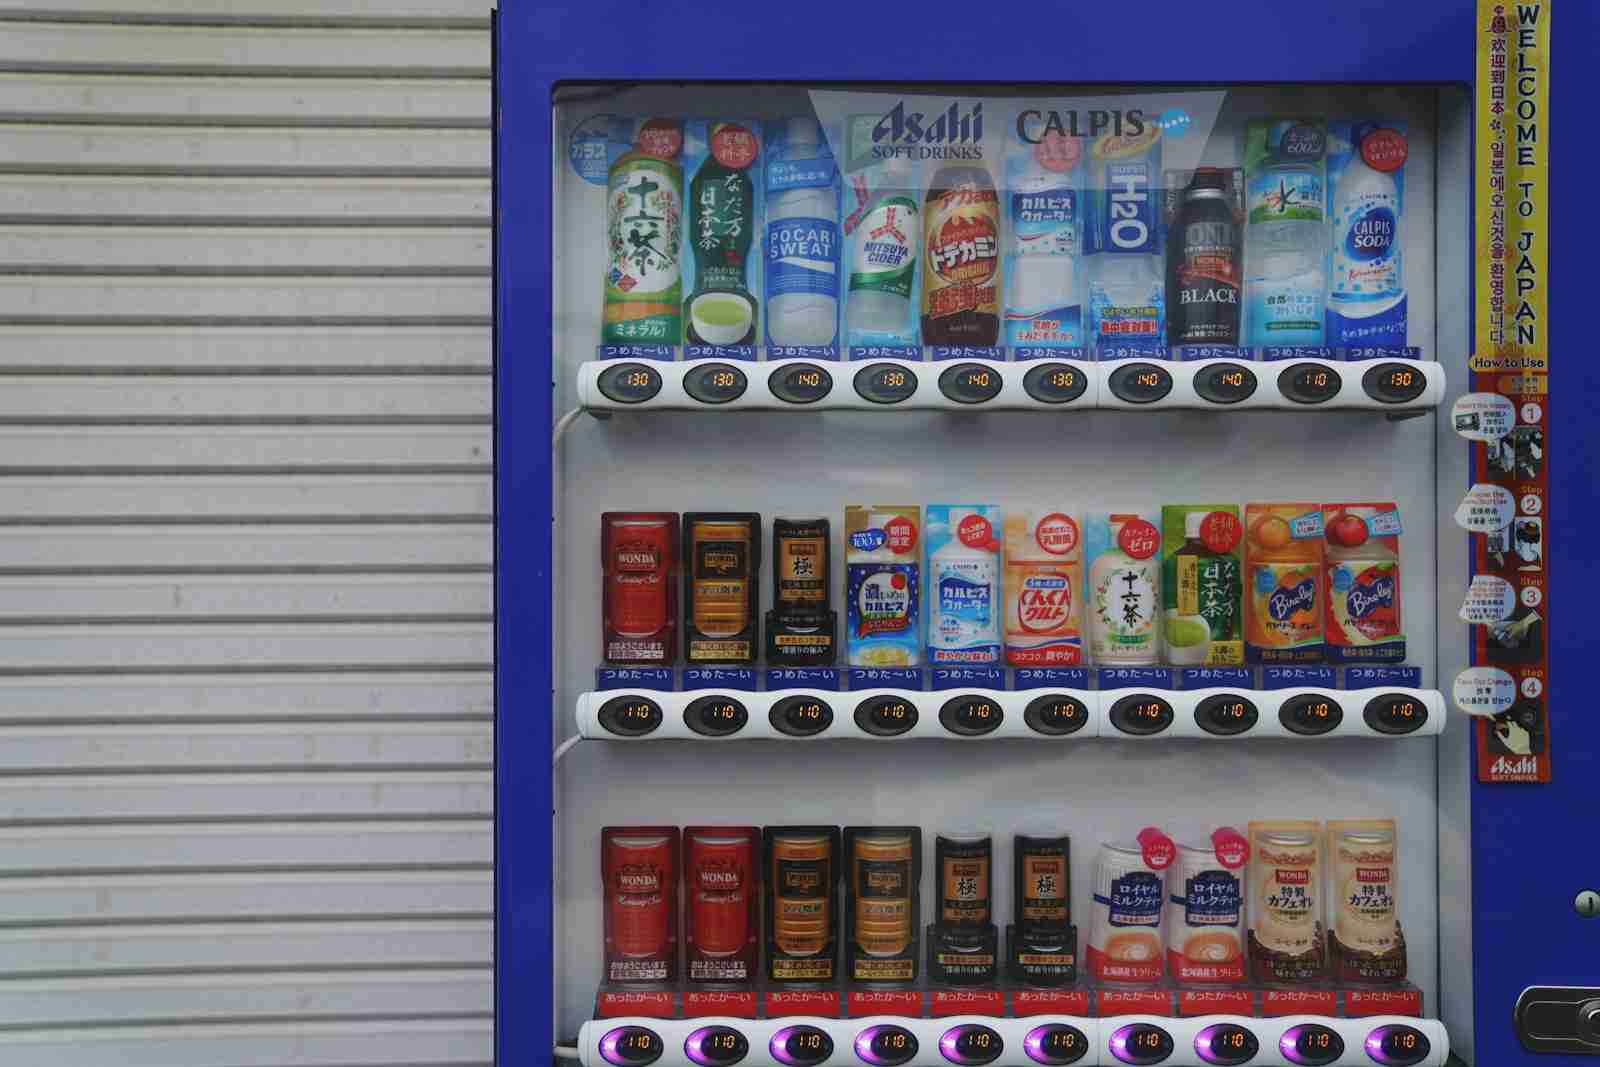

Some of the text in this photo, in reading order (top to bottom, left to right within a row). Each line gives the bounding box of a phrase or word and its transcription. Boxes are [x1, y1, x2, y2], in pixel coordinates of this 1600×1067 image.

[871, 100, 983, 144] Asahi
[1016, 109, 1145, 144] CALPIS
[871, 146, 983, 160] SOFT DRINKS
[1515, 4, 1540, 345] WELCOME TO JAPAN
[1021, 197, 1072, 210] カルピス
[623, 176, 674, 276] 十六茶
[698, 187, 721, 252] 日本茶
[1353, 220, 1391, 236] CALPIS
[770, 229, 834, 244] POCARI
[1353, 235, 1391, 249] SODA
[770, 242, 832, 259] SWEAT
[863, 241, 909, 257] MITSUYA
[931, 236, 998, 273] ドデカミン
[867, 252, 902, 265] CIDER
[1180, 287, 1238, 304] BLACK
[1475, 358, 1544, 368] How to Use
[628, 373, 649, 386] 130
[713, 373, 734, 386] 130
[799, 373, 819, 386] 140
[882, 373, 904, 386] 130
[968, 373, 989, 386] 140
[1052, 373, 1073, 386] 130
[1137, 373, 1158, 386] 140
[1222, 373, 1242, 386] 140
[1305, 373, 1326, 386] 110
[1391, 373, 1412, 386] 130
[1527, 407, 1535, 420] 1
[1526, 498, 1537, 511] 2
[1128, 538, 1154, 552] ゼロ
[943, 587, 989, 599] カルピス
[1120, 570, 1143, 628] 十六茶
[1527, 591, 1537, 603] 3
[1527, 681, 1537, 694] 4
[628, 704, 649, 719] 110
[713, 704, 735, 719] 110
[799, 704, 820, 719] 110
[883, 704, 904, 719] 110
[969, 704, 990, 719] 110
[1053, 704, 1074, 719] 110
[1137, 704, 1158, 719] 110
[1223, 704, 1243, 719] 110
[1307, 704, 1328, 719] 110
[1391, 704, 1413, 719] 110
[1490, 756, 1537, 774] Asahi
[620, 873, 657, 885] WONDA
[701, 871, 738, 883] WONDA
[630, 1034, 650, 1048] 110
[714, 1034, 736, 1048] 110
[800, 1034, 820, 1048] 110
[884, 1034, 905, 1048] 110
[968, 1034, 990, 1048] 110
[1052, 1034, 1074, 1048] 110
[1137, 1034, 1159, 1048] 110
[1222, 1034, 1244, 1048] 110
[1307, 1034, 1329, 1048] 110
[1393, 1034, 1415, 1048] 110
